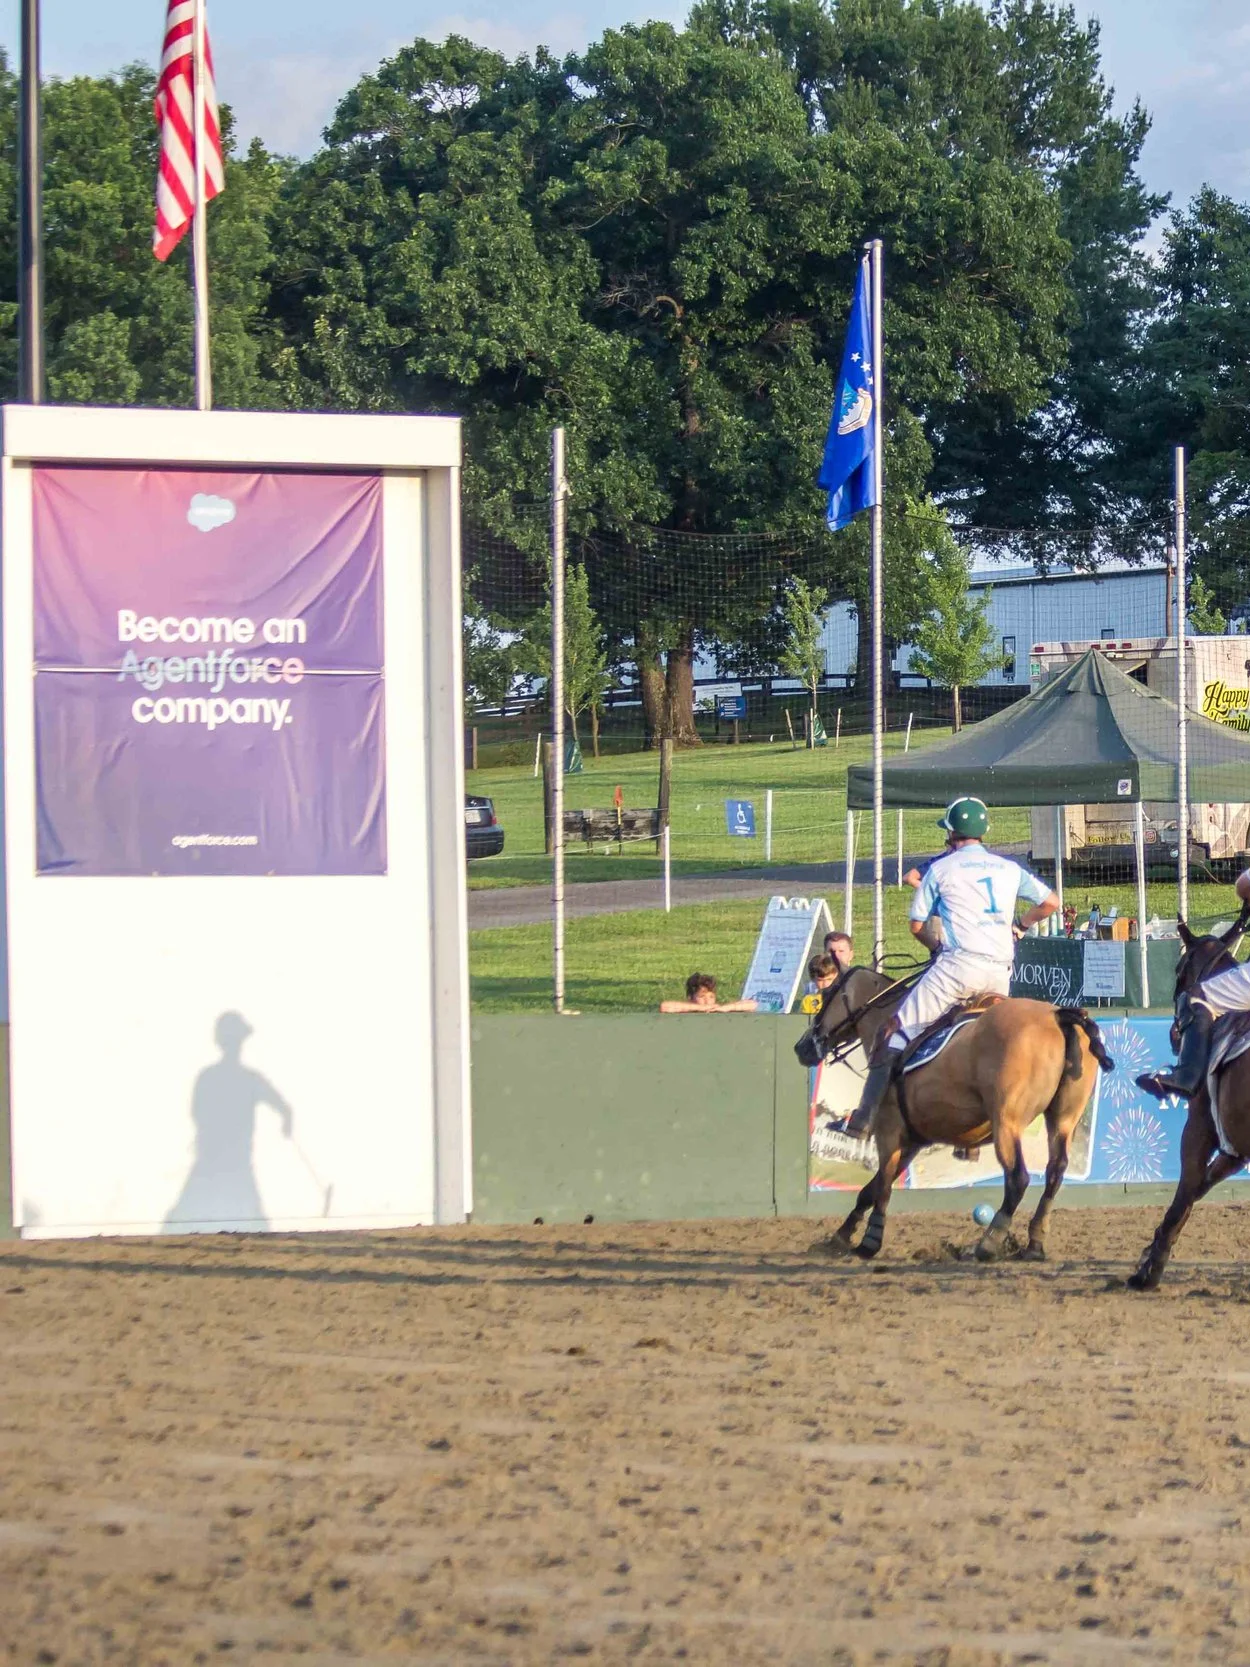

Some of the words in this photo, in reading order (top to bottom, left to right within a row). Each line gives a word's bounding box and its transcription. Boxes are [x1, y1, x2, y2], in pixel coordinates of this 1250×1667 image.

[118, 609, 255, 643] Become
[262, 617, 307, 643] an
[116, 648, 305, 693] Agentforce
[1202, 681, 1250, 712] Happy
[131, 696, 293, 731] company.
[171, 833, 259, 849] agentforce.com
[976, 876, 1004, 913] 1
[1010, 962, 1073, 989] MORVEN
[1048, 979, 1087, 1009] Park
